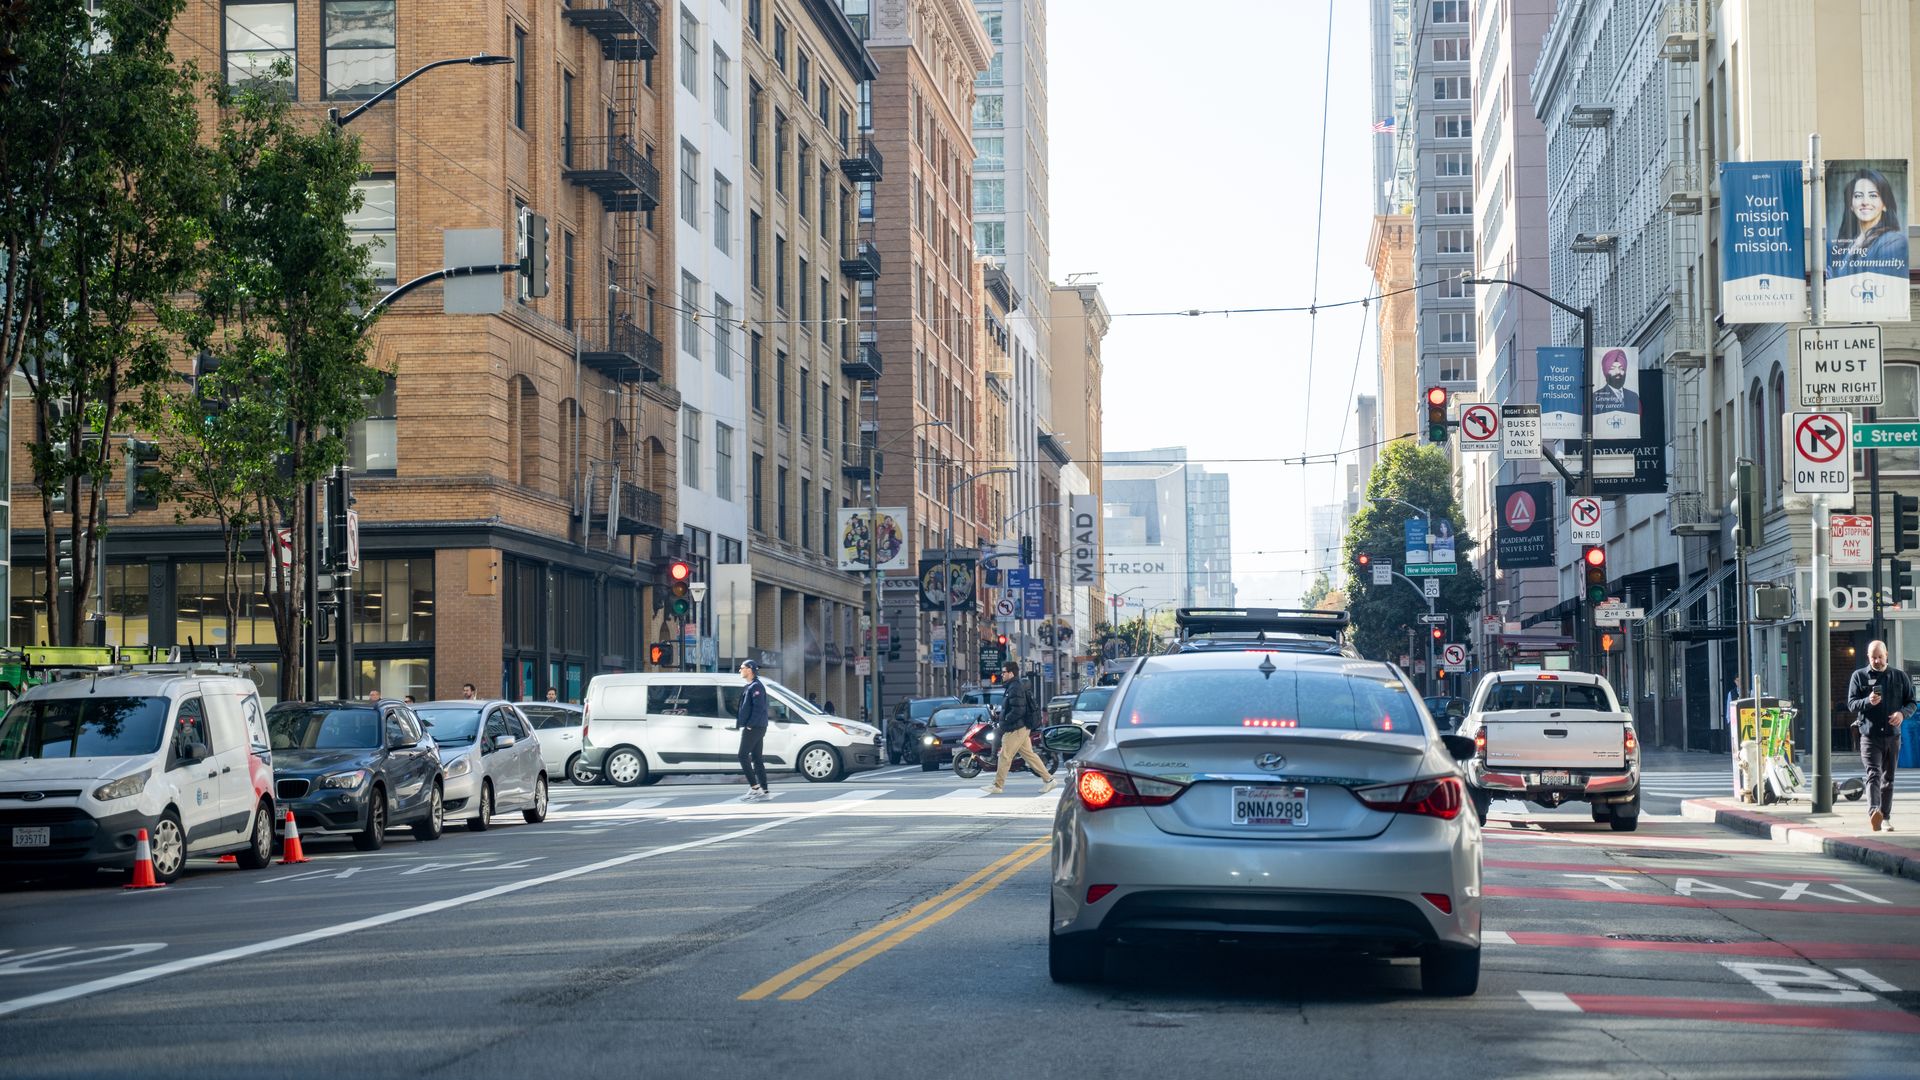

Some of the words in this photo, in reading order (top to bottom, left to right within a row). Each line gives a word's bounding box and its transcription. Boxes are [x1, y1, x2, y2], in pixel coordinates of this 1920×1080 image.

[1745, 195, 1778, 207] Your
[1736, 210, 1789, 222] mission
[1743, 225, 1755, 237] is
[1758, 226, 1782, 237] our
[1735, 240, 1792, 252] mission.
[1832, 245, 1868, 257] Serving
[1832, 260, 1848, 270] my
[1849, 258, 1905, 270] community.
[1804, 340, 1839, 350] RIGHT
[1844, 339, 1876, 349] LANE
[1550, 365, 1569, 373] Your
[1815, 360, 1867, 373] MUST
[1805, 383, 1836, 394] TURN
[1842, 382, 1877, 393] RIGHT
[1804, 396, 1827, 404] EXCEPT
[1871, 429, 1918, 442] Street
[1636, 447, 1659, 456] ART
[1798, 471, 1815, 484] ON
[1820, 470, 1845, 483] RED
[1573, 531, 1583, 539] ON
[1586, 531, 1600, 539] RED
[1832, 526, 1843, 536] NO
[1844, 527, 1871, 536] STOPPING
[1500, 536, 1528, 544] ACADEMY
[1500, 544, 1545, 553] UNIVERSITY
[1843, 549, 1861, 557] TIME
[1104, 562, 1164, 574] TREON
[1237, 801, 1303, 819] 8NNA988
[15, 834, 47, 844] 19357T1
[1563, 873, 1894, 905] TAXI
